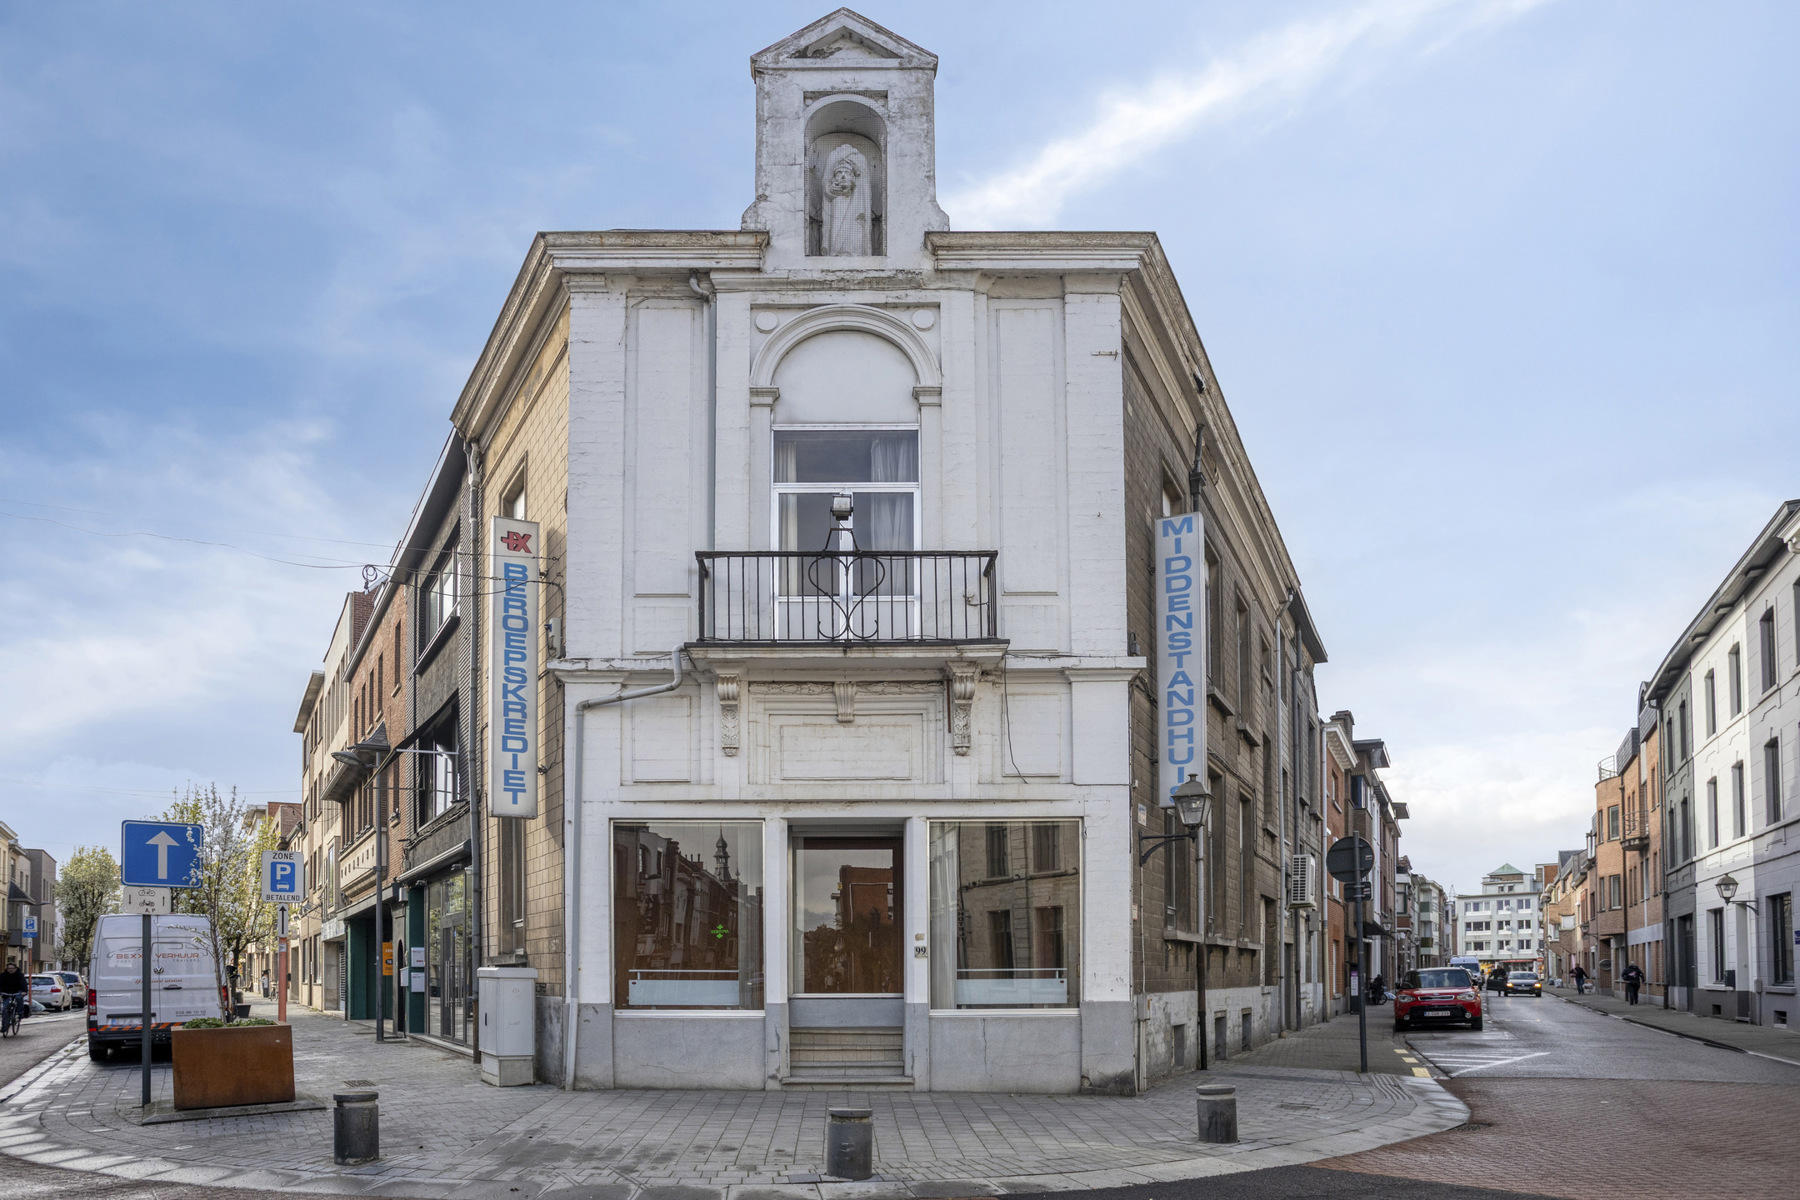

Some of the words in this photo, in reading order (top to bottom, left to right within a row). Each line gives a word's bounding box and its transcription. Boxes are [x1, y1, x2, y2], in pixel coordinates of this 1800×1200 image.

[501, 562, 529, 805] BEROEPSKREDIET
[272, 852, 294, 860] ZONE
[276, 864, 292, 880] P
[915, 946, 926, 955] 99
